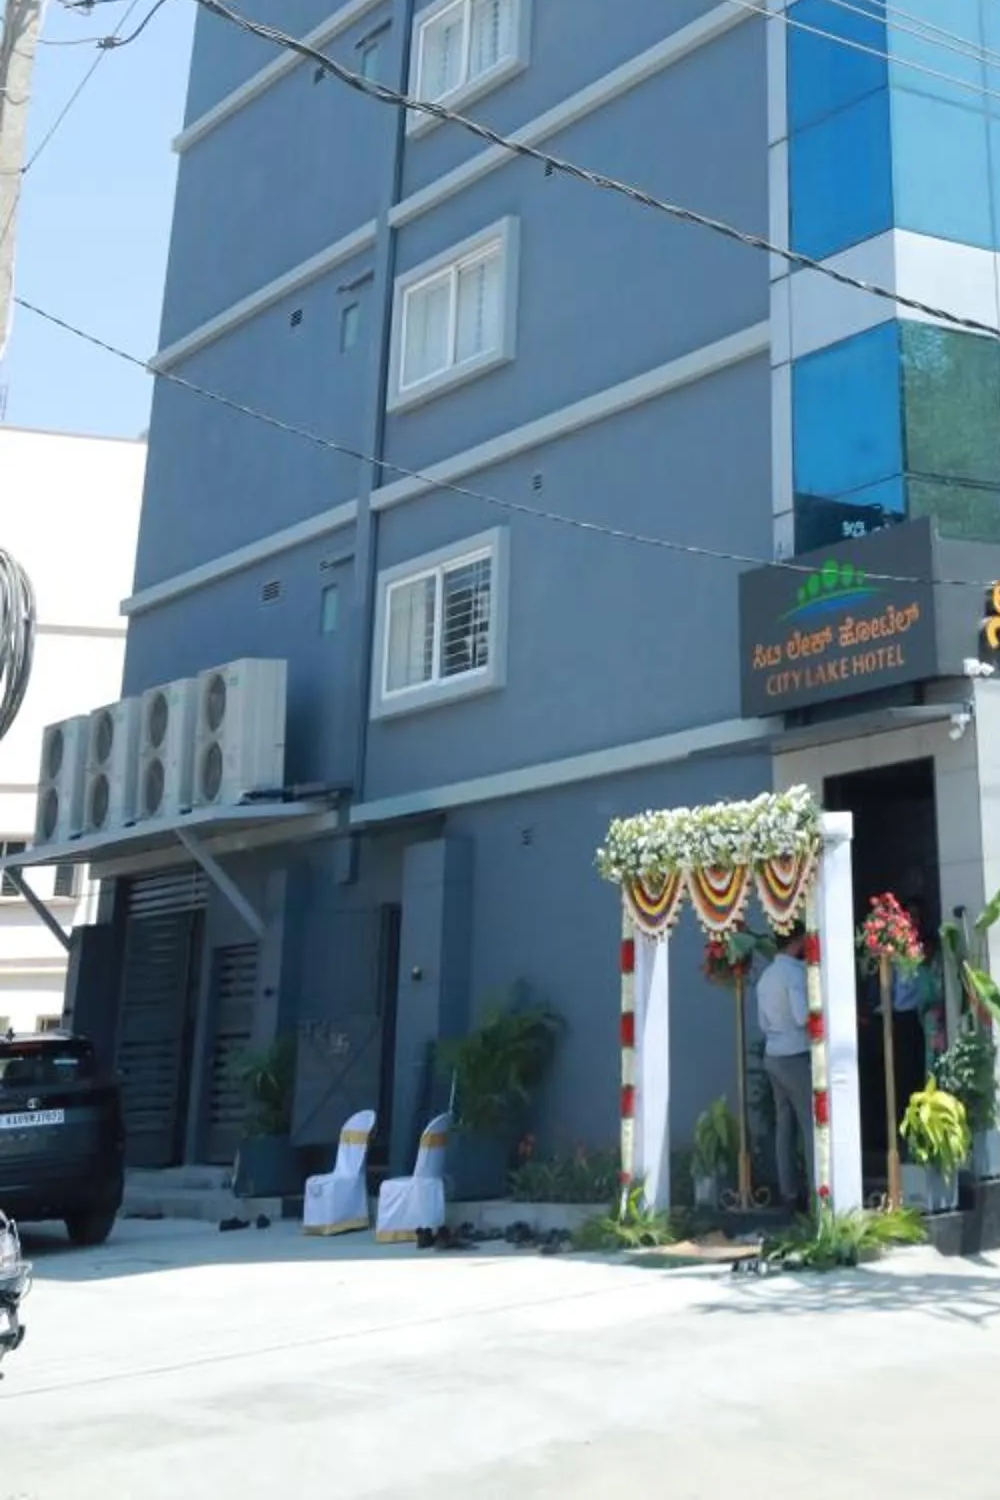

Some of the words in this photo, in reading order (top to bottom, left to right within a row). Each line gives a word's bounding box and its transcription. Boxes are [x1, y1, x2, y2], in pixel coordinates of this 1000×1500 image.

[753, 643, 782, 669] ಸಿಟಿ
[786, 626, 833, 660] ಲೇಕ್
[838, 601, 920, 647] ಹೋಟೆಲ್
[766, 668, 802, 696] CITY
[805, 656, 849, 688] LAKE
[852, 643, 905, 675] HOTEL
